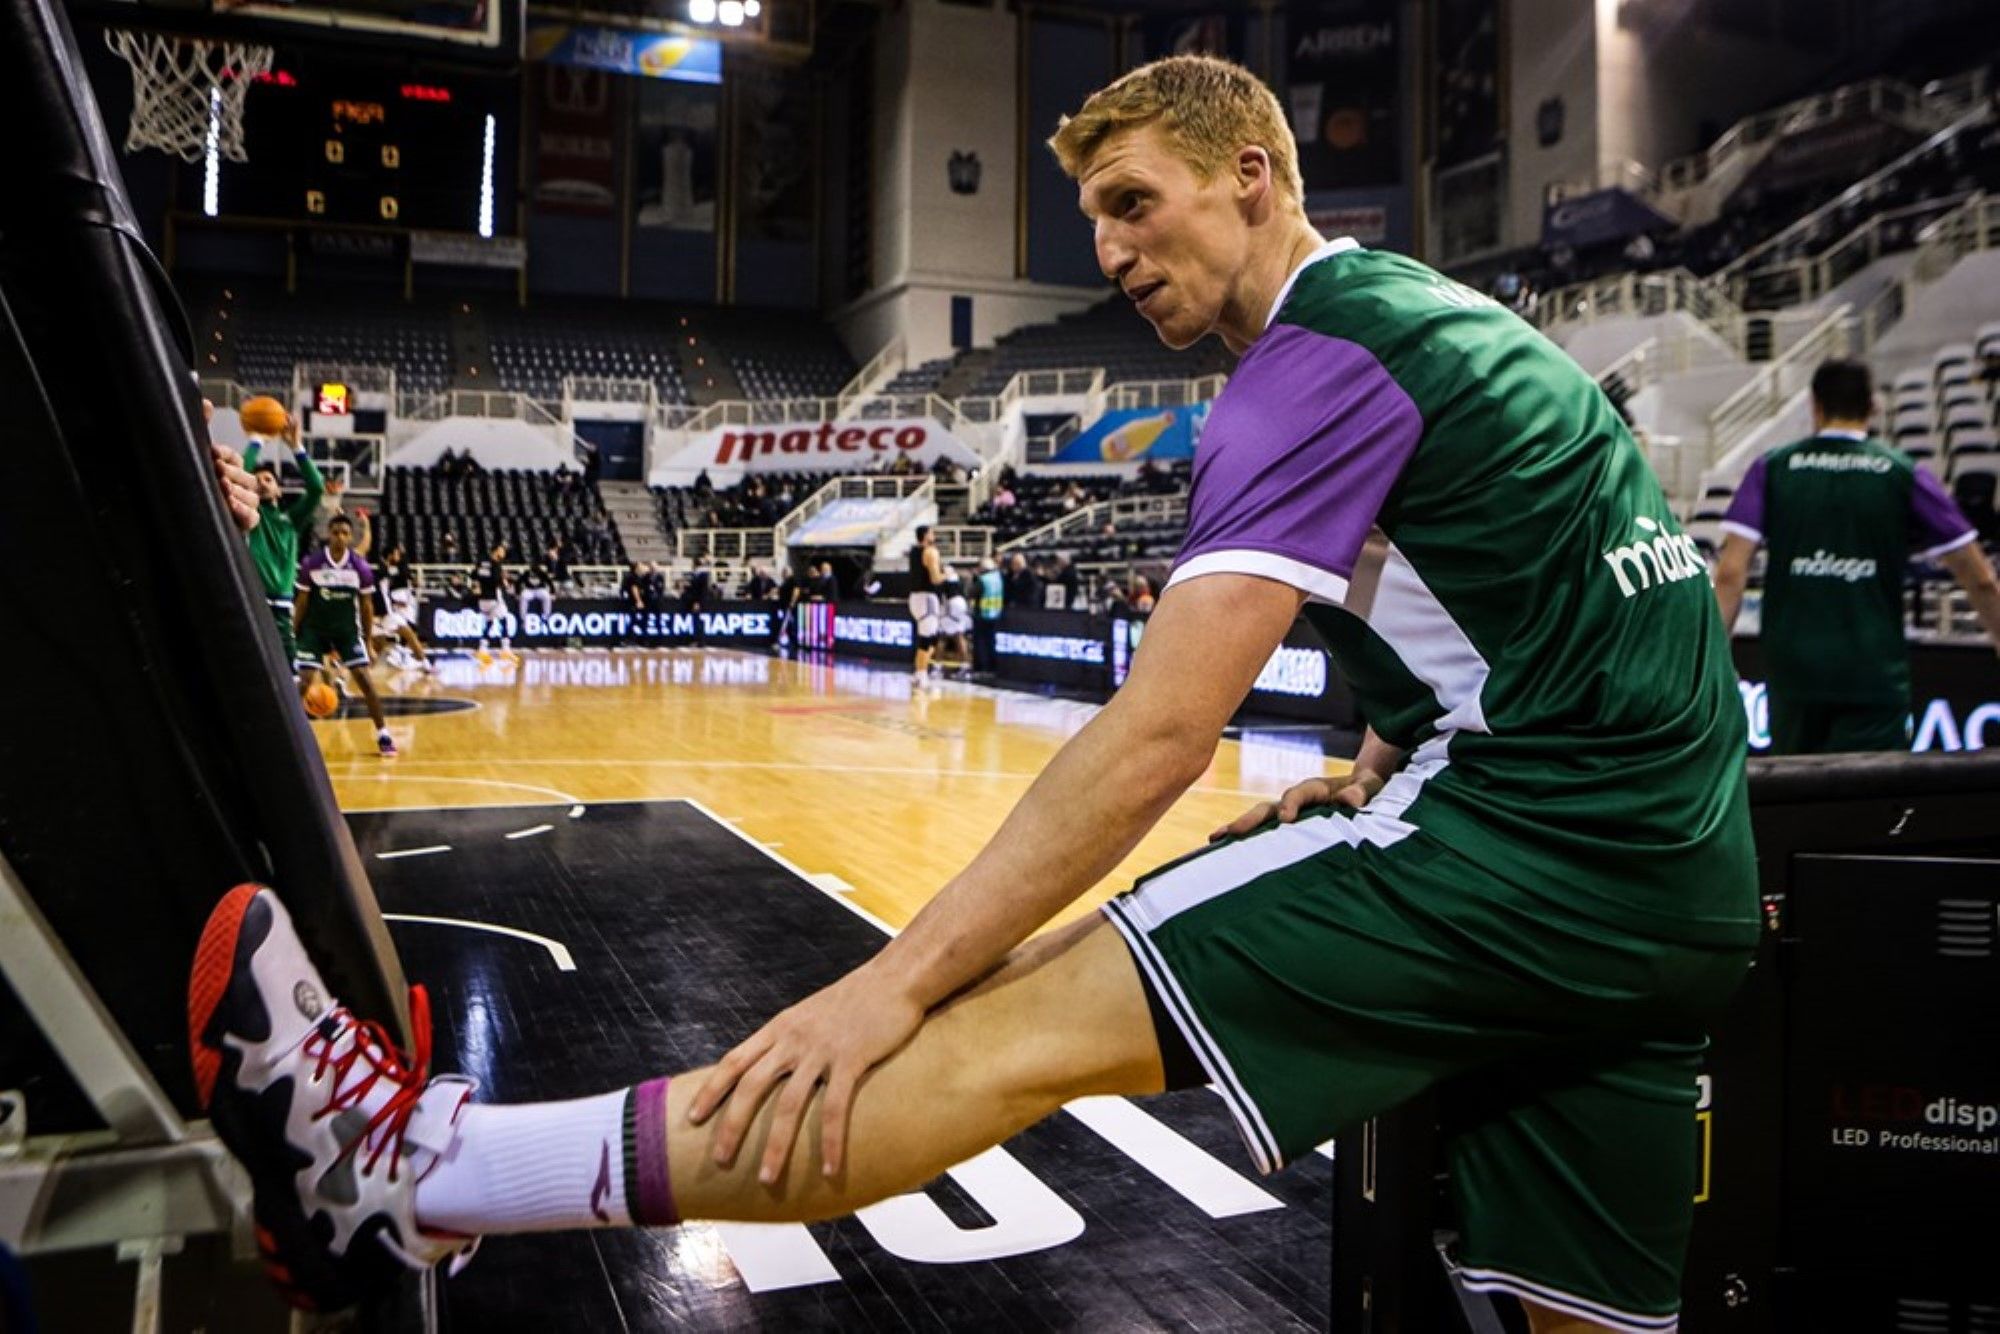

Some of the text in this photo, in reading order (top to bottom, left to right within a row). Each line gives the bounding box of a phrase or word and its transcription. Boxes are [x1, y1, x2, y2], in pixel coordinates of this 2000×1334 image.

[715, 421, 927, 465] mateco
[1831, 1127, 1999, 1155] LED Professional
